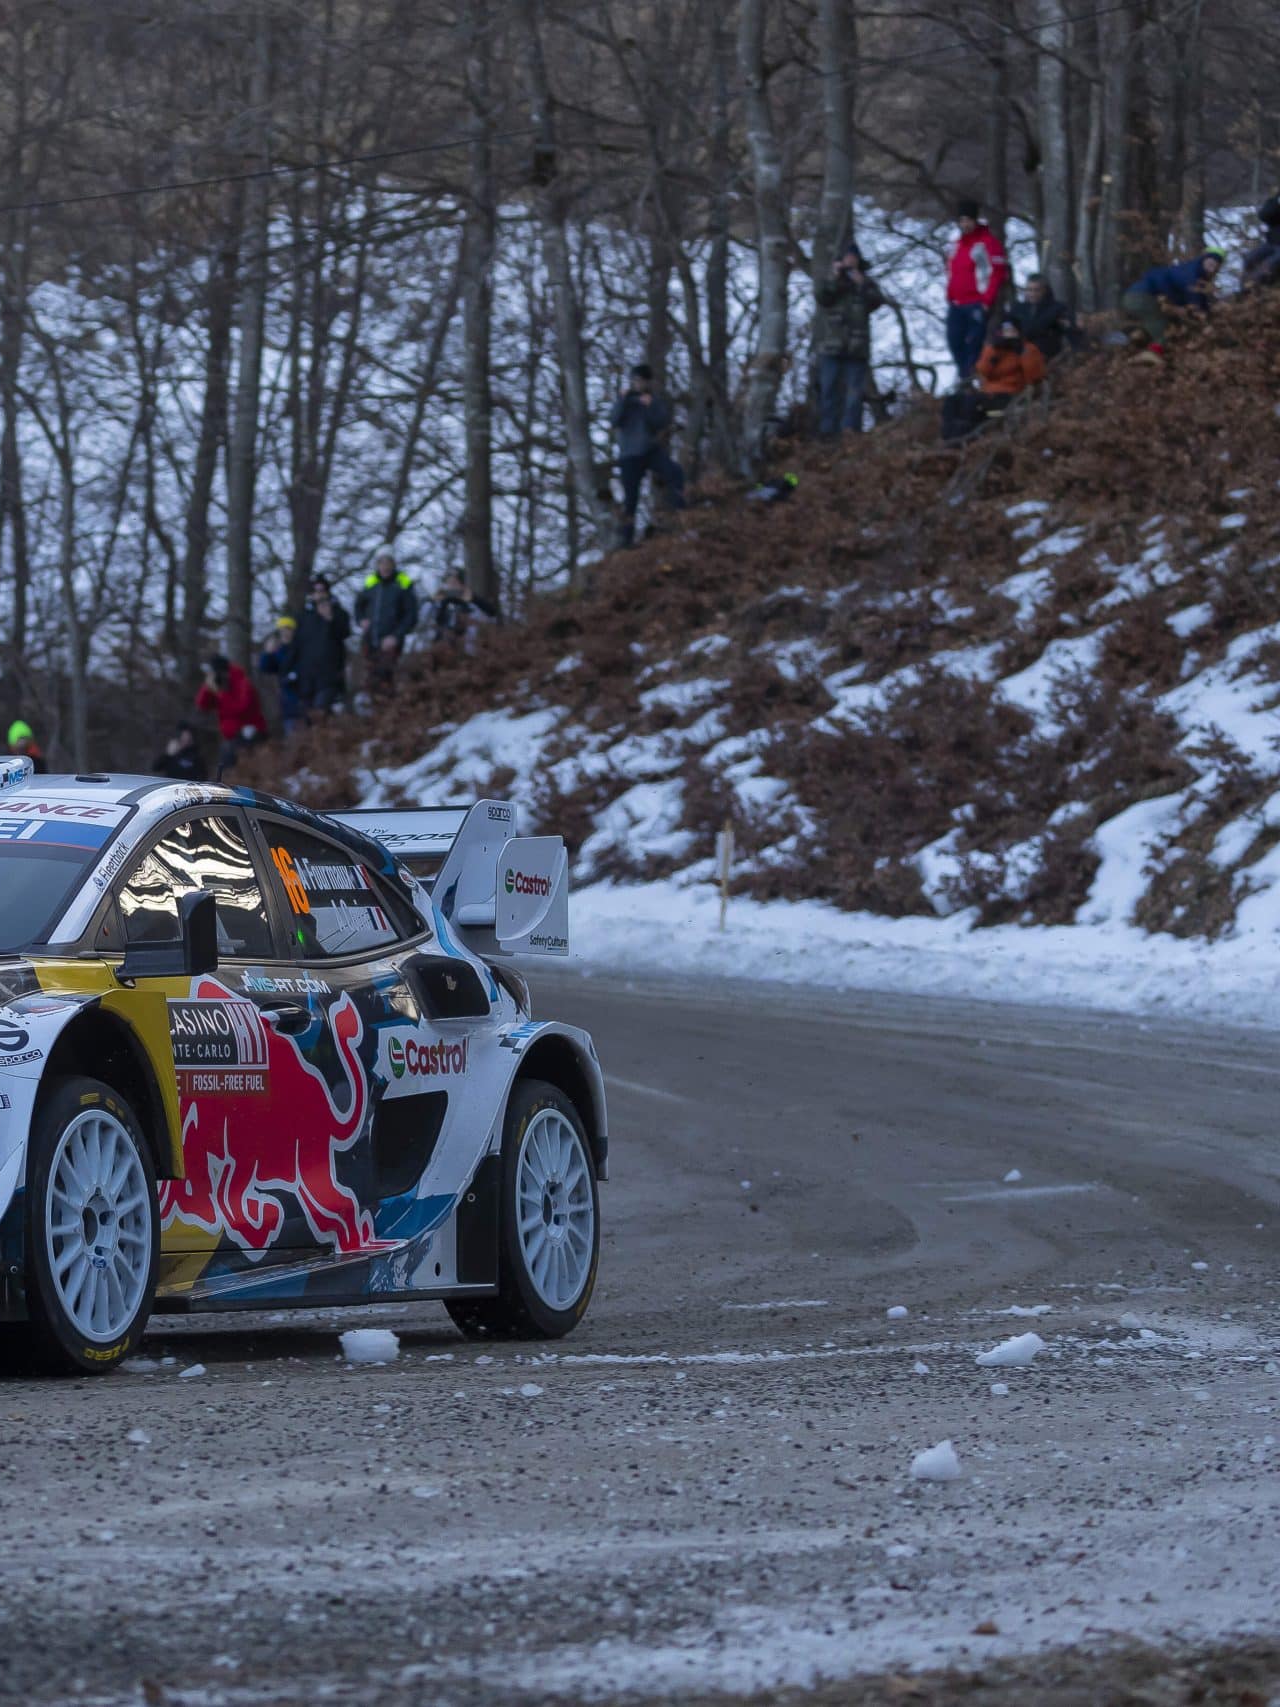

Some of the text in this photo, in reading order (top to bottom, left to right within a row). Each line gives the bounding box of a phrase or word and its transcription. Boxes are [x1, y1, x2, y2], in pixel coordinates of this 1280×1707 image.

[269, 847, 311, 915] 16
[515, 871, 551, 896] Castrol
[529, 935, 568, 949] SafetyCulture
[170, 1007, 230, 1035] ASINO
[406, 1037, 466, 1075] Castrol
[192, 1074, 245, 1091] FOSSIL-FREE
[245, 1074, 265, 1091] FUEL
